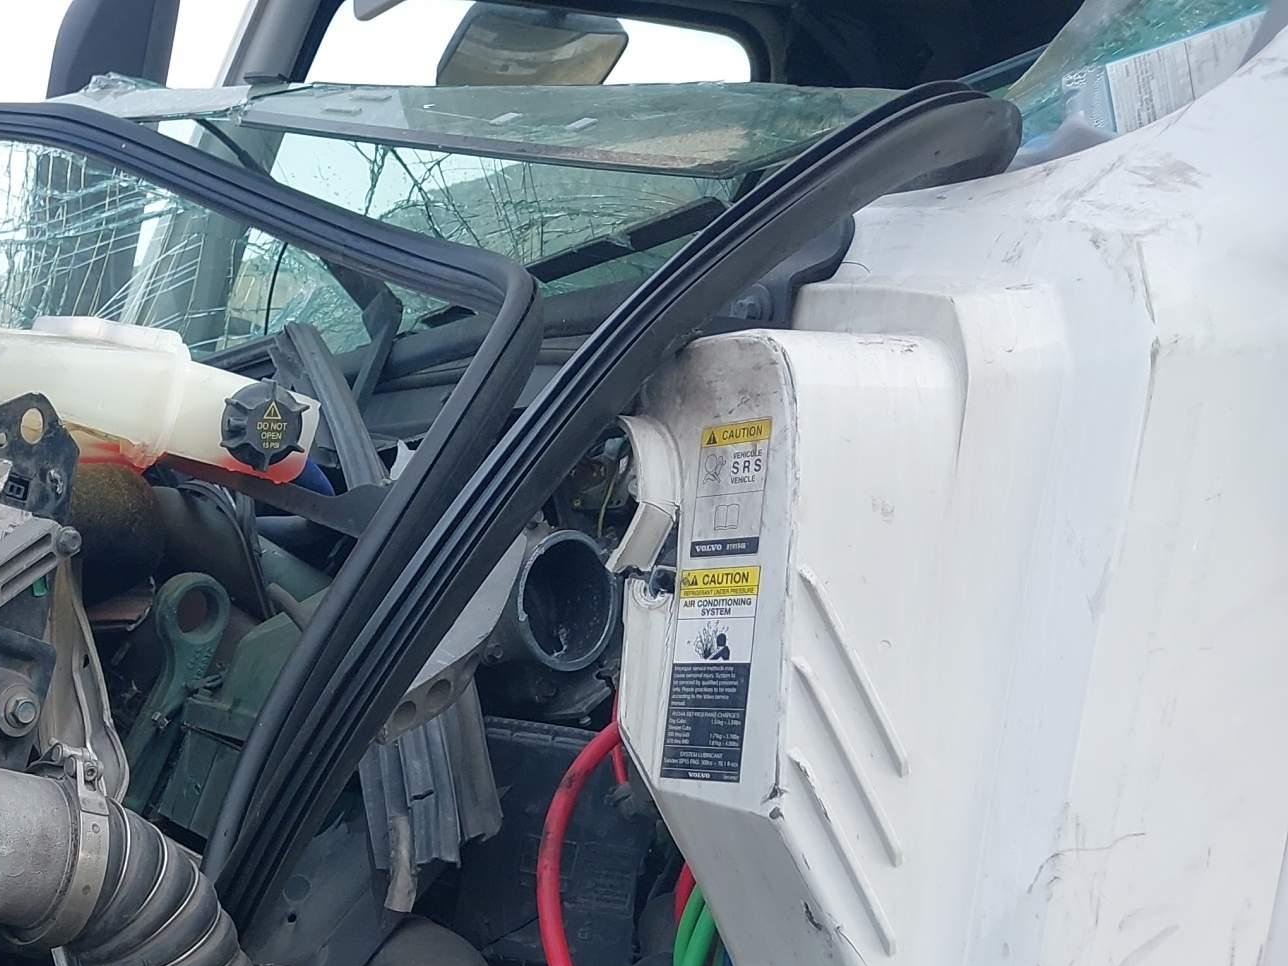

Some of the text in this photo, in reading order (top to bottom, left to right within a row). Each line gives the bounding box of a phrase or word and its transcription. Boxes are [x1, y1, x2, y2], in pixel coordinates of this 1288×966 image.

[257, 422, 288, 431] DO NOT
[261, 432, 282, 440] OPEN
[722, 425, 763, 441] CAUTION
[730, 475, 756, 484] VEHICLE
[695, 544, 722, 553] VOLVO
[702, 571, 750, 586] CAUTION
[683, 597, 752, 608] AIR CONDITIONING
[700, 607, 732, 616] SYSTEM
